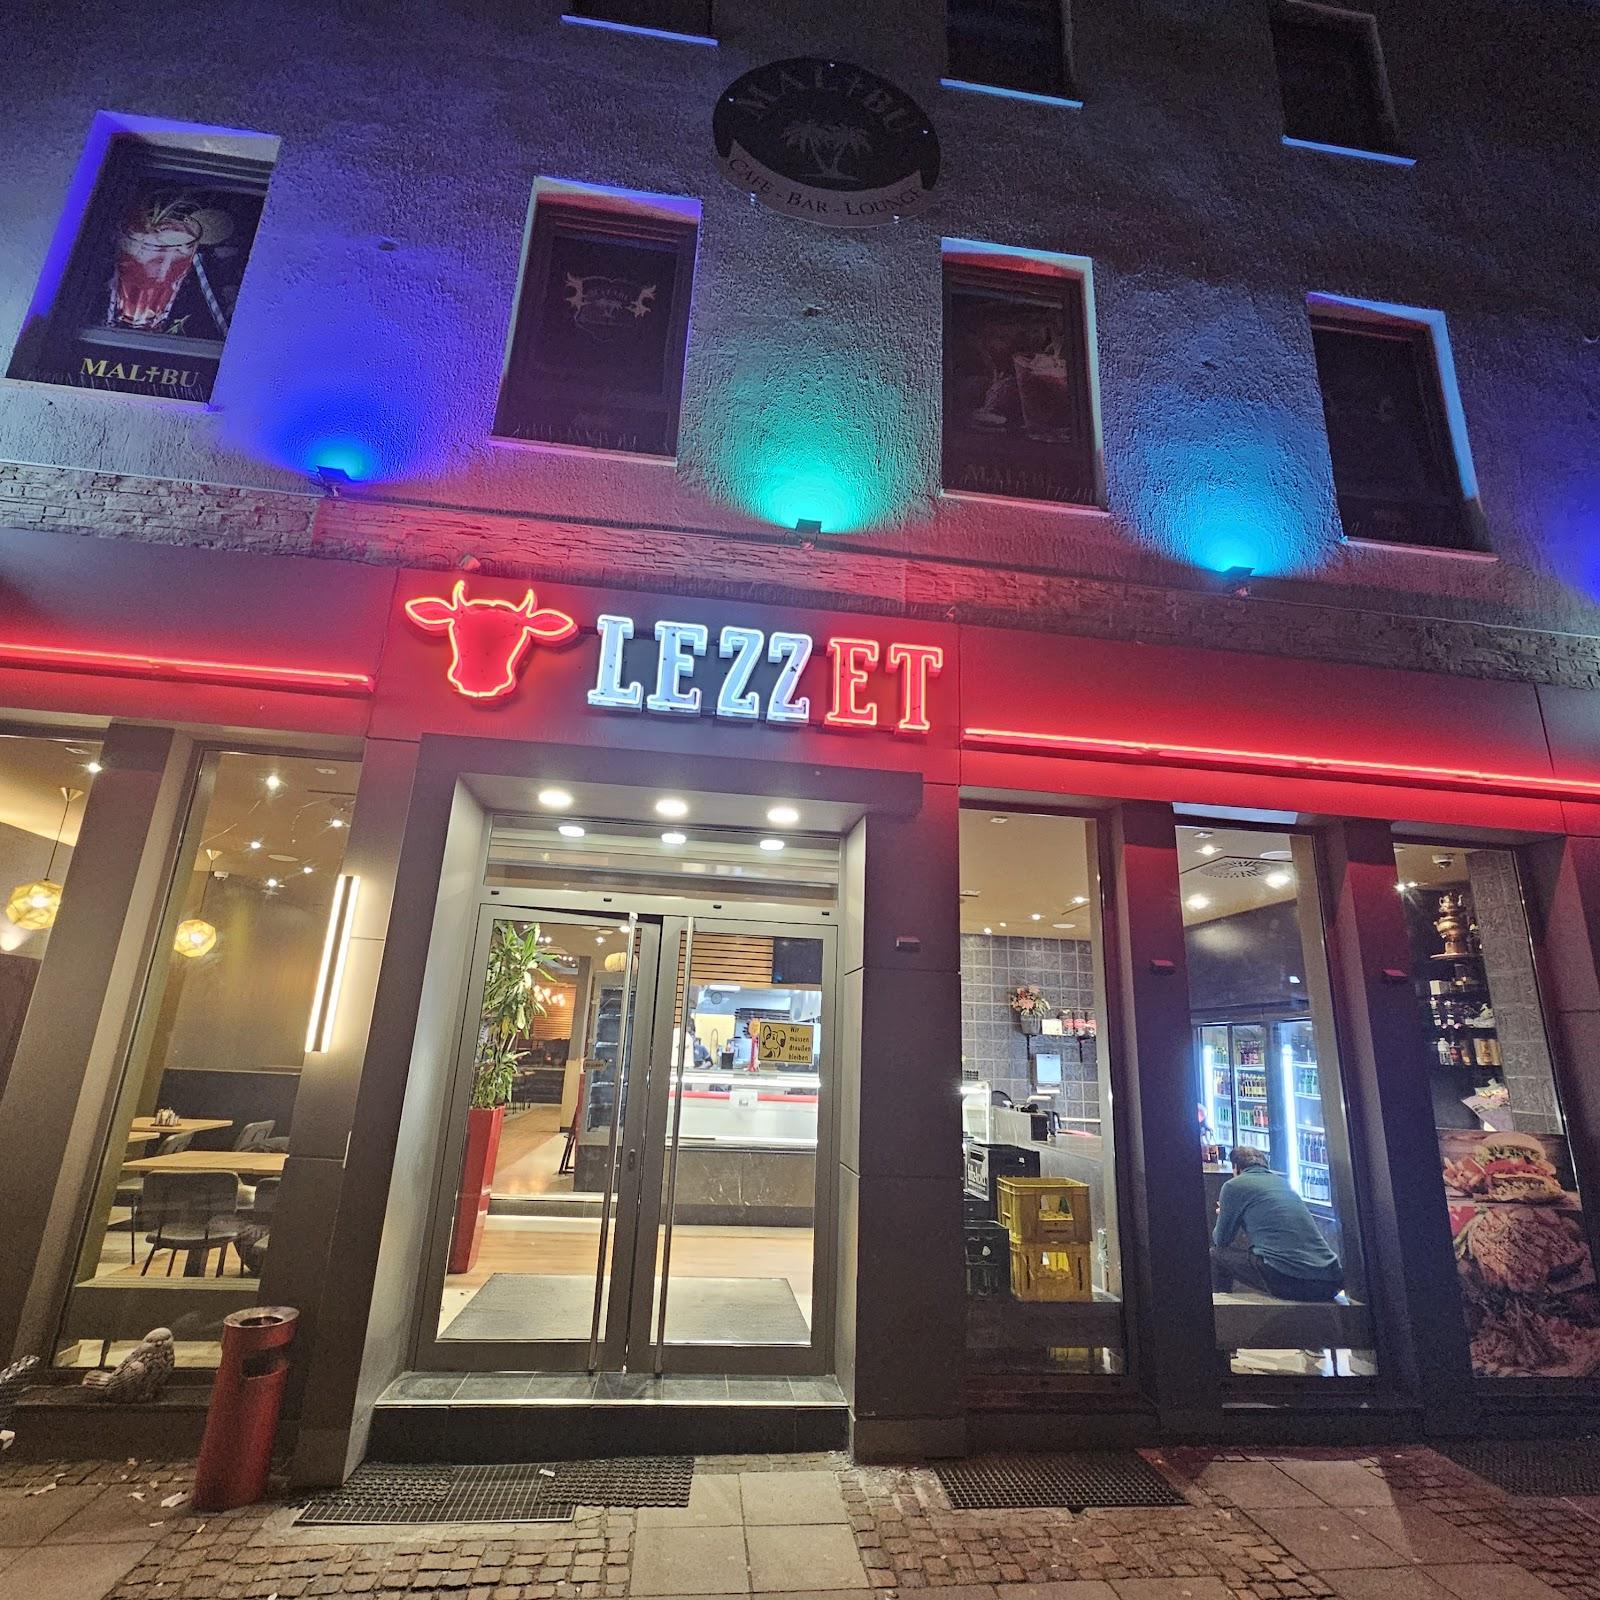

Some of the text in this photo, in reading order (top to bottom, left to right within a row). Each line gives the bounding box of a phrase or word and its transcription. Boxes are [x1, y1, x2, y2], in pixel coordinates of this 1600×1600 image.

[787, 191, 828, 215] BAR
[844, 186, 921, 216] LOUNGE
[587, 614, 943, 733] LEZZET
